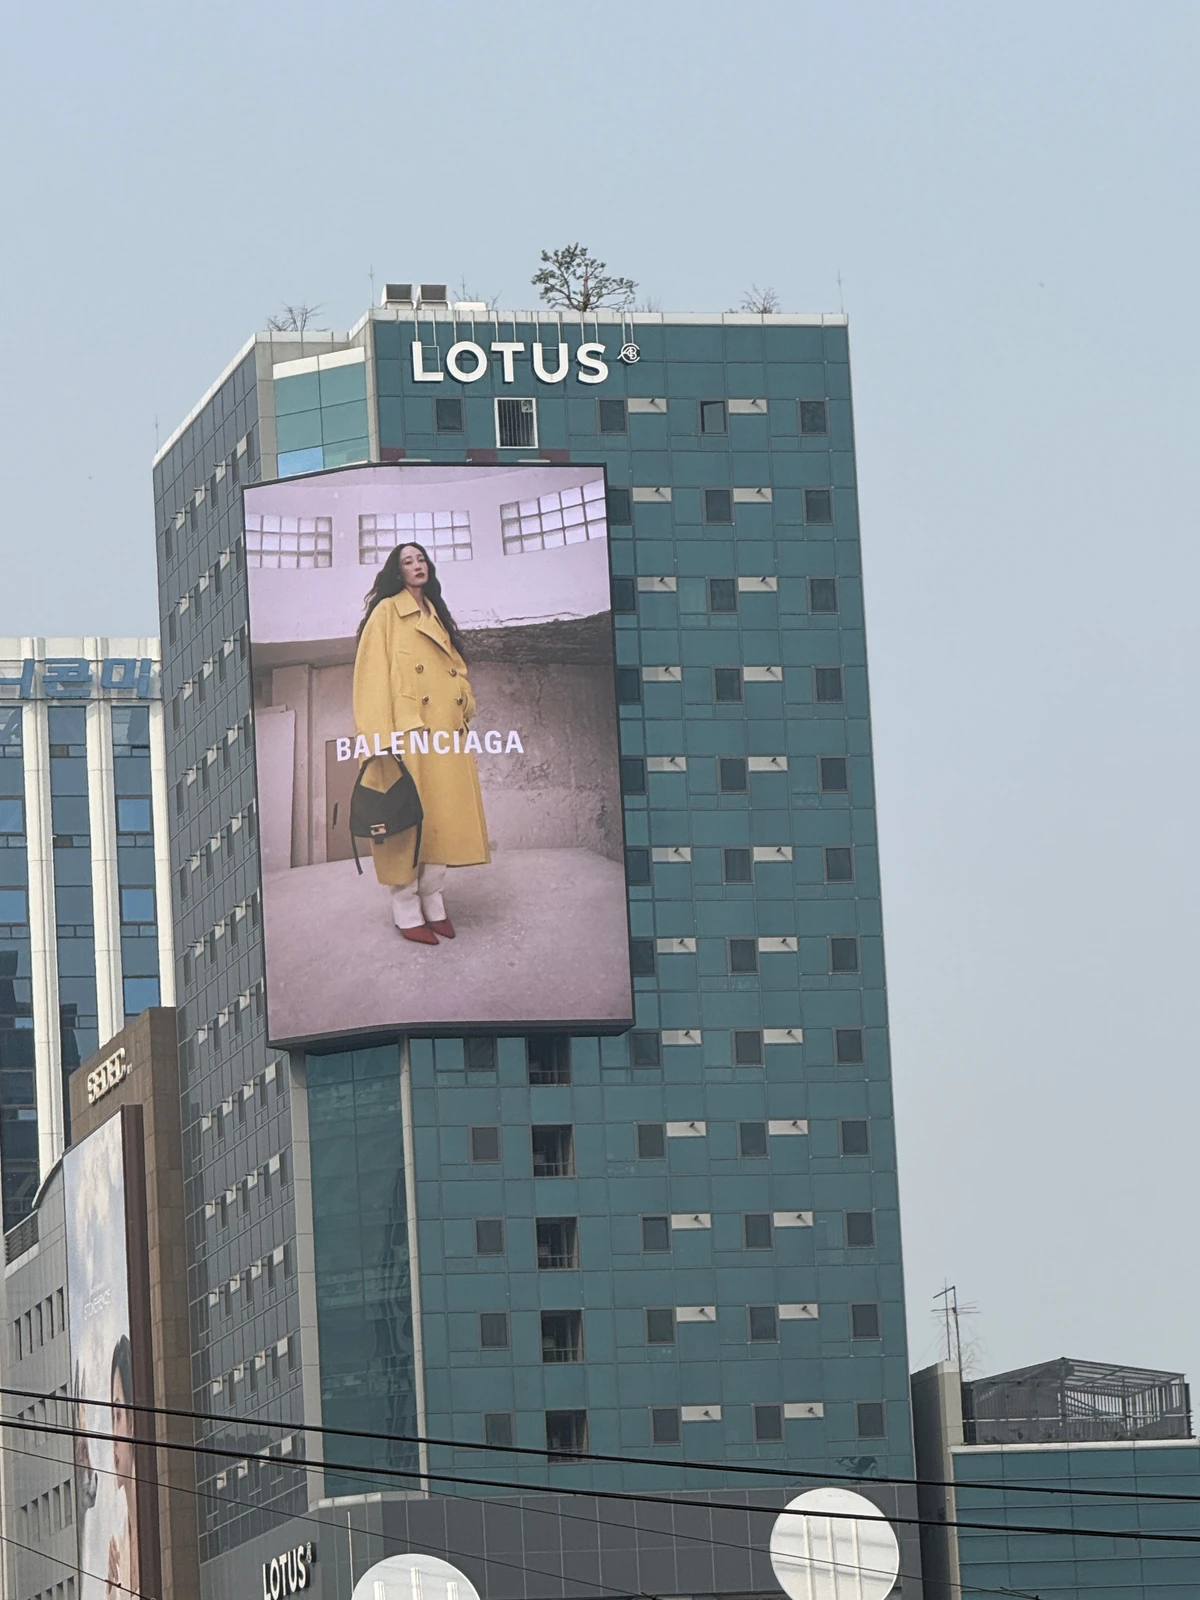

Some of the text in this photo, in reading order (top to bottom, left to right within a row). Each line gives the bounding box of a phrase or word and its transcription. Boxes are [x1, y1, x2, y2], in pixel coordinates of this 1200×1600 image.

[411, 341, 609, 384] LOTUS
[335, 729, 525, 762] BALENCIAGA
[262, 1545, 306, 1600] LOTUS
